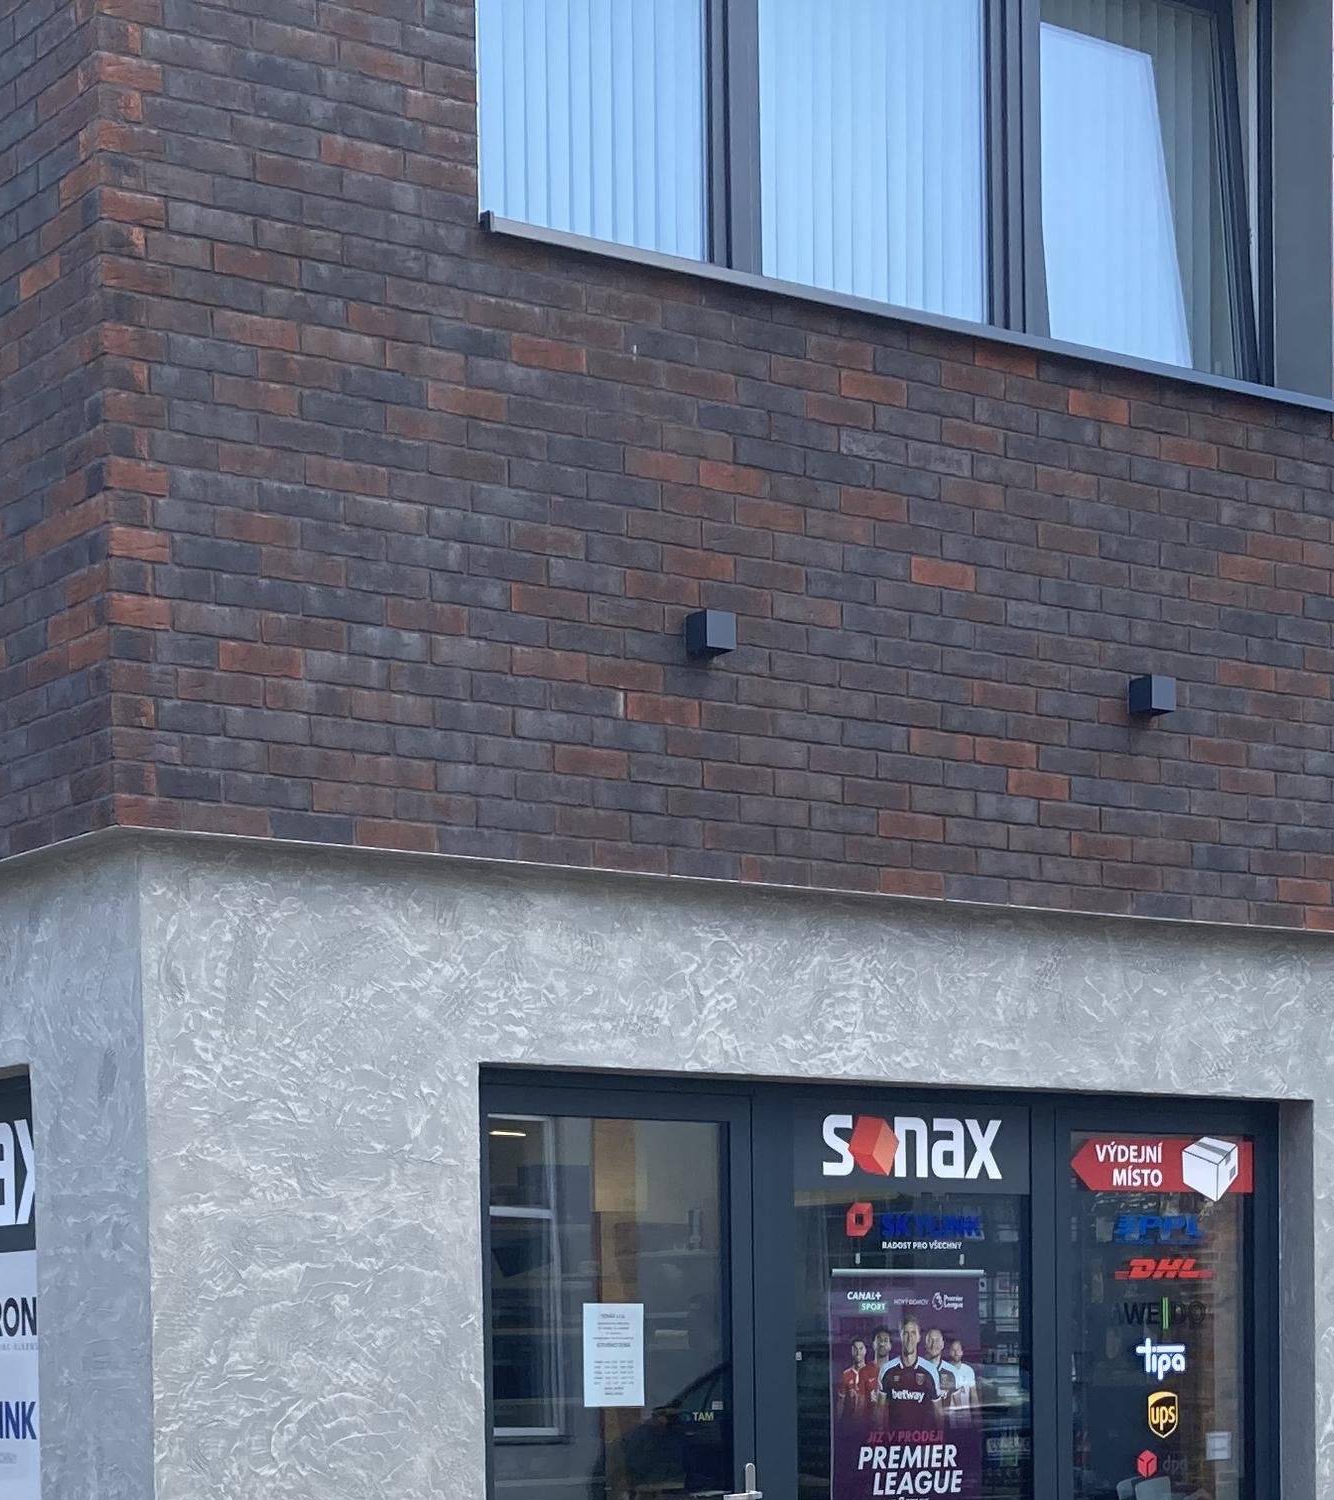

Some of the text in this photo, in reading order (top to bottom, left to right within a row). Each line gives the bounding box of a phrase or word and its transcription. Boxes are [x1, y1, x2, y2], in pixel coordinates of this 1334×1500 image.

[1096, 1141, 1162, 1163] VÝDEJNÍ
[1113, 1165, 1162, 1187] MÍSTO
[882, 1241, 911, 1249] RADOST
[1129, 1259, 1197, 1278] DHL
[861, 1303, 886, 1311] SPORT
[1136, 1338, 1186, 1381] tipa
[892, 1389, 924, 1403] betway
[693, 1412, 714, 1421] TAM
[1151, 1405, 1176, 1431] ups
[858, 1445, 957, 1469] PREMIER
[873, 1470, 963, 1495] LEAGUE
